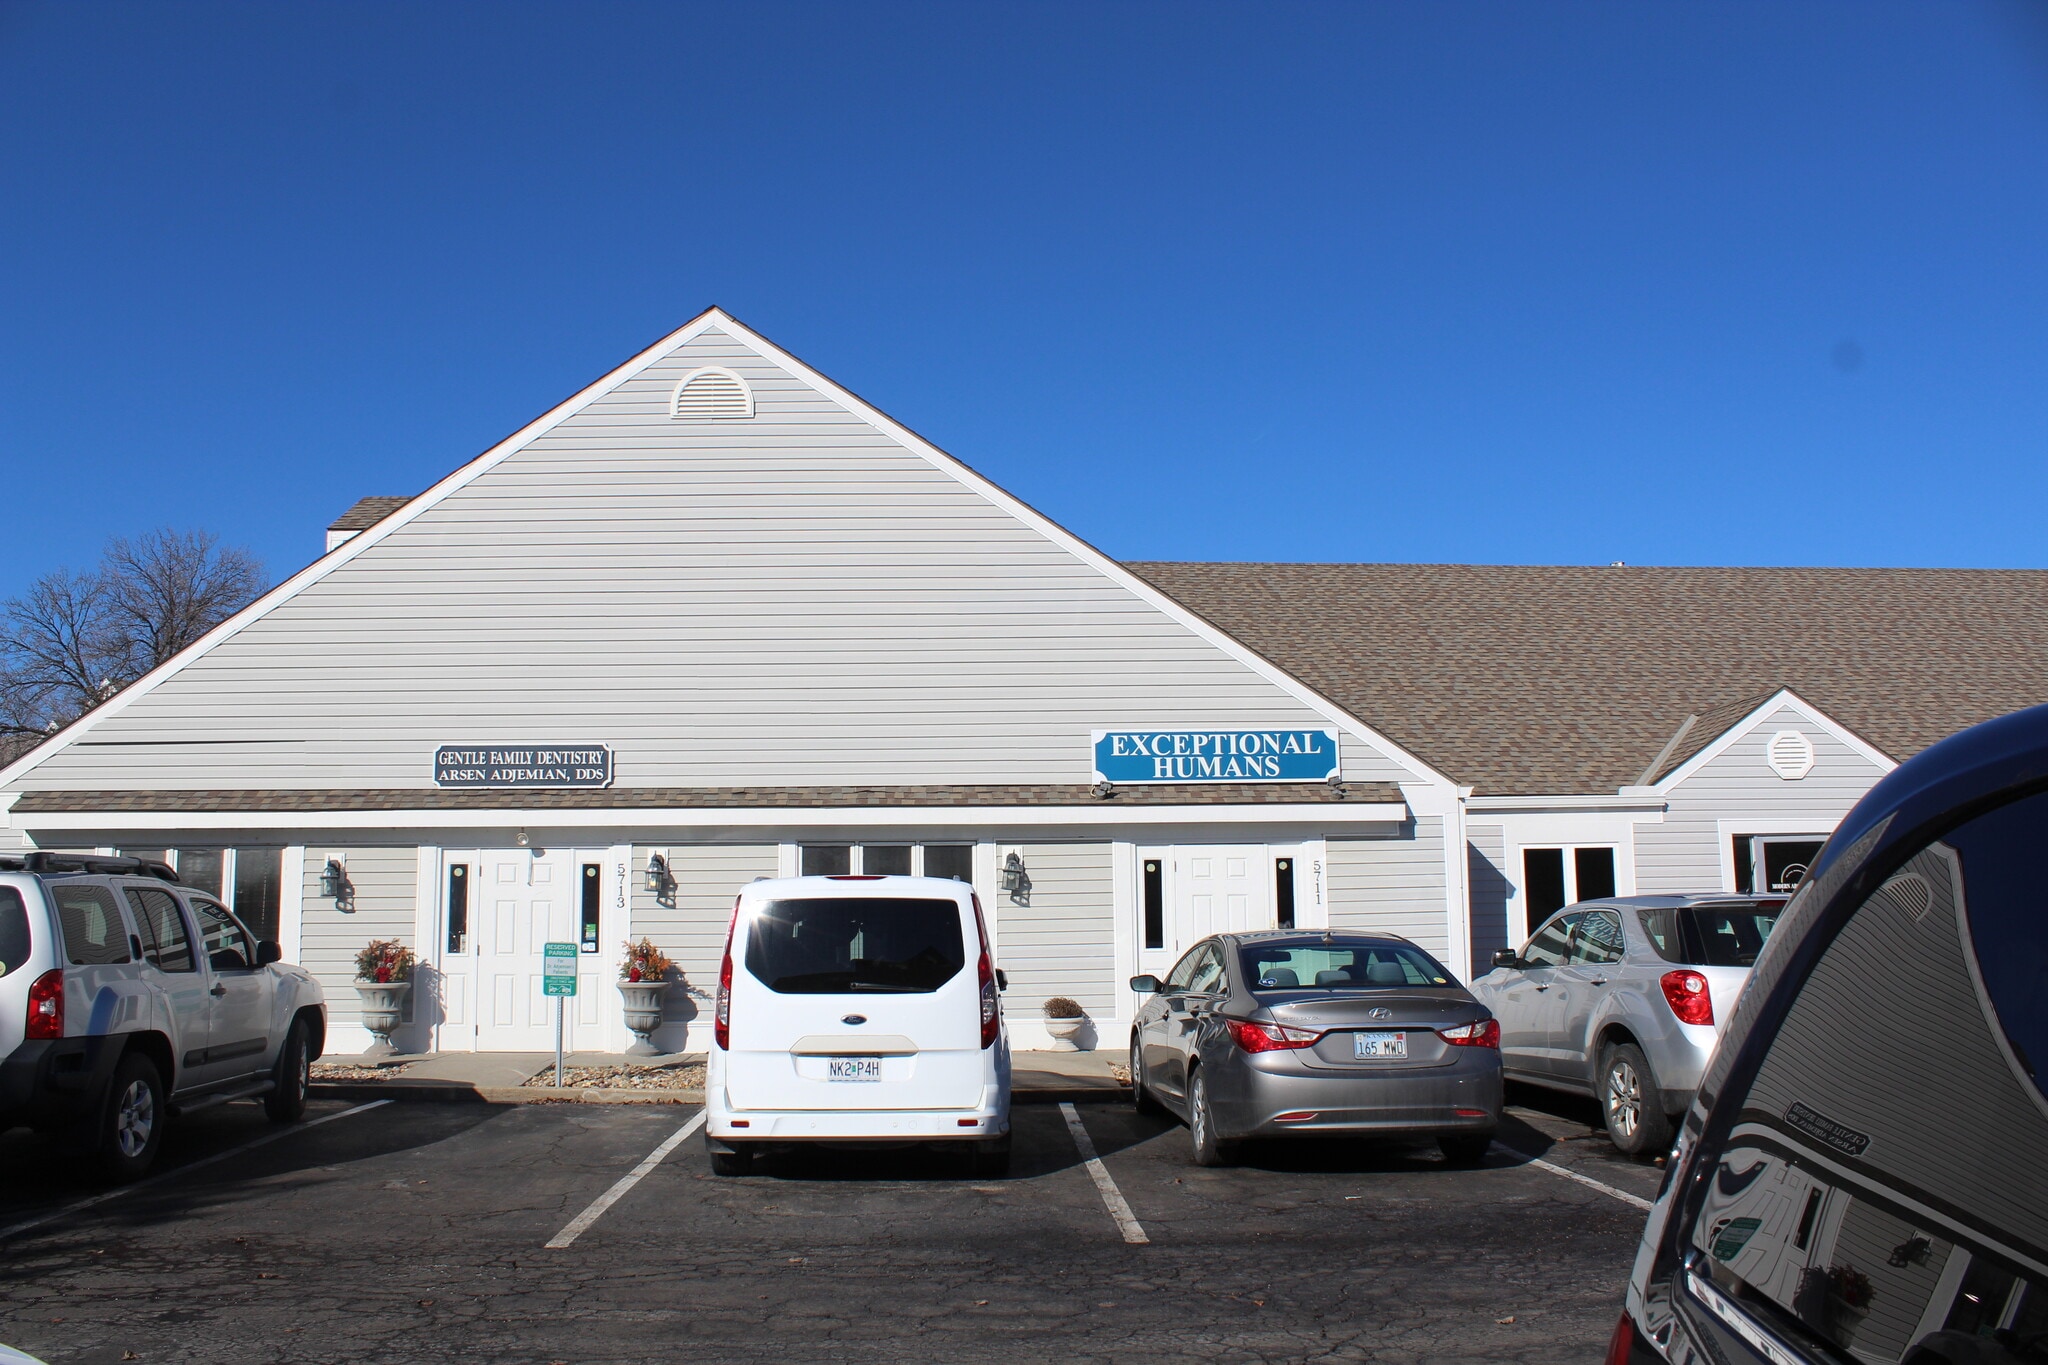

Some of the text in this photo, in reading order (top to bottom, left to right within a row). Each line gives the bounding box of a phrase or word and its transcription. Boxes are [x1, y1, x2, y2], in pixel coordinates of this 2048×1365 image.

[1110, 733, 1321, 756] EXCEPTIONAL
[439, 750, 604, 765] GENTLE FAMILY DENTISTRY
[438, 768, 604, 783] ARSEN ADJEMIAN, DDS
[1152, 756, 1280, 778] HUMANS
[617, 863, 626, 909] 5713
[1313, 860, 1322, 905] 5711
[1359, 1041, 1378, 1055] 165
[830, 1061, 879, 1076] NK2 P4H
